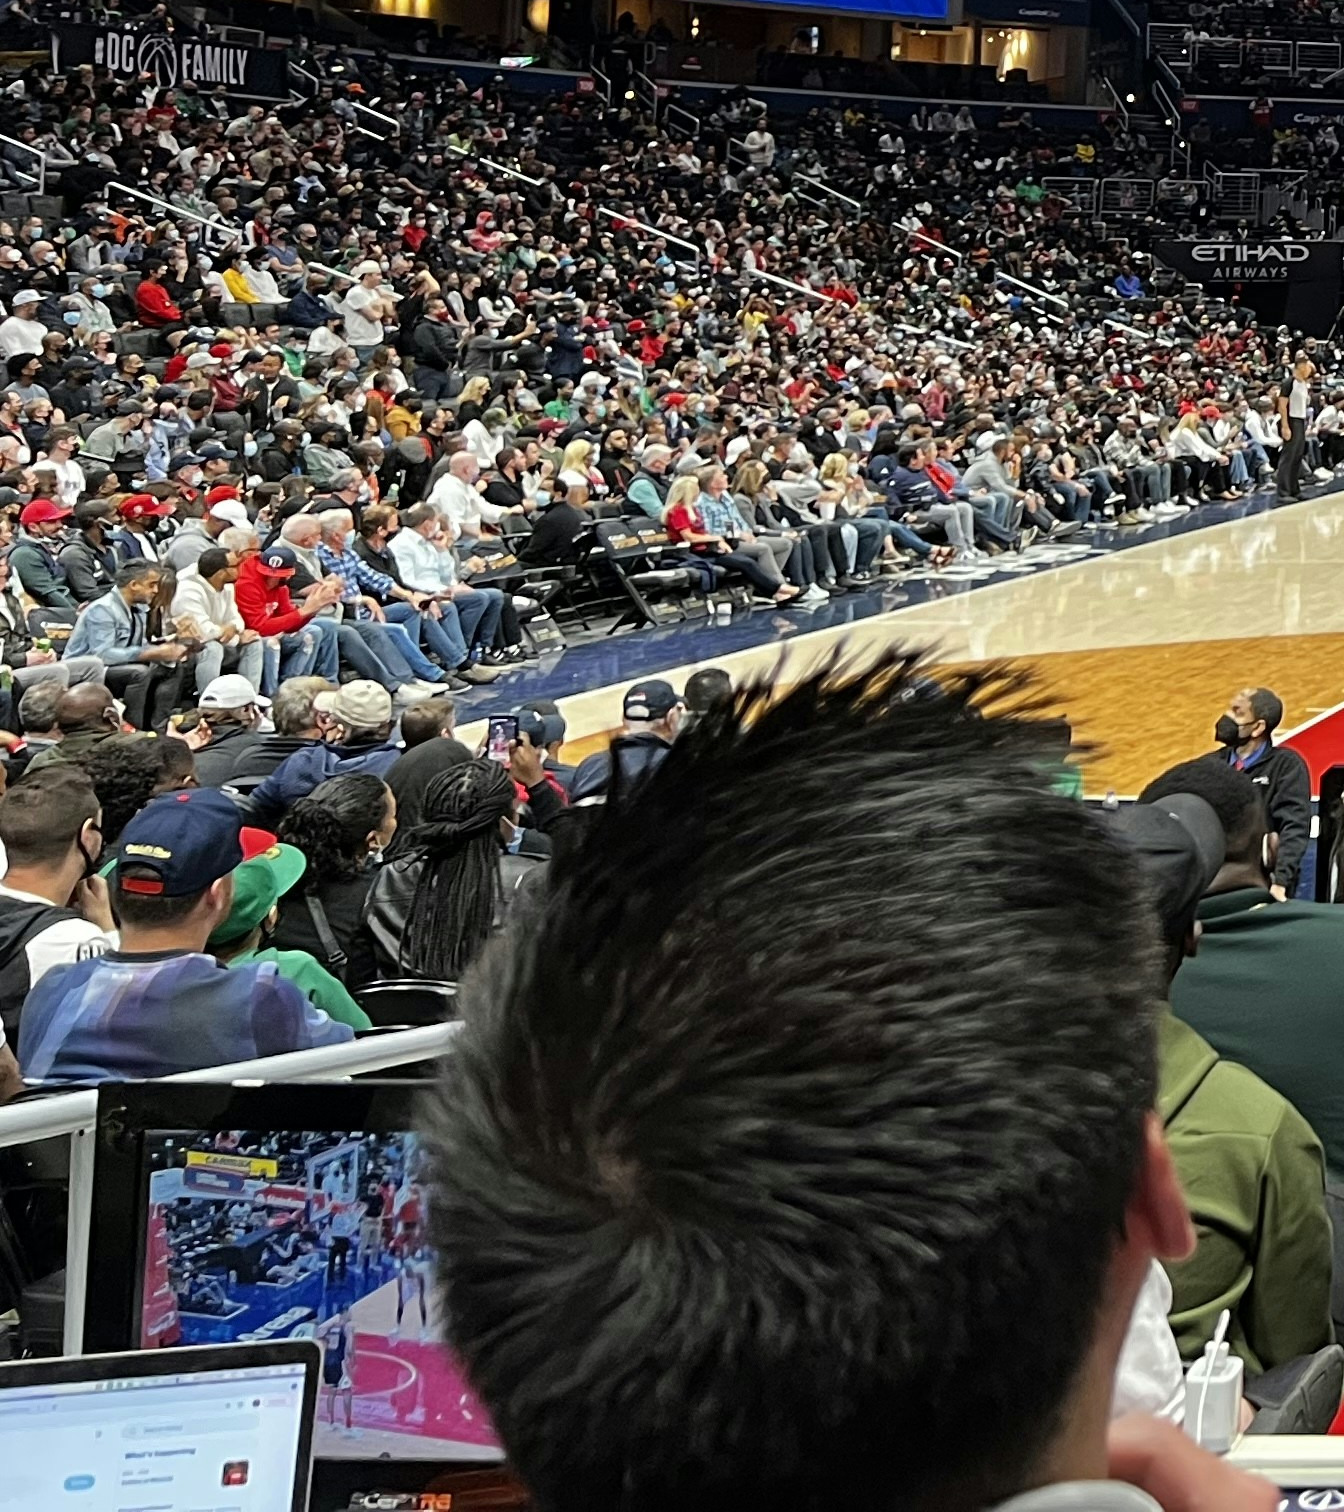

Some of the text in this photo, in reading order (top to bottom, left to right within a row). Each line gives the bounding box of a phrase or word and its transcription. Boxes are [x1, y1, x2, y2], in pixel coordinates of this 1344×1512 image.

[182, 43, 248, 85] FAMILY
[1191, 243, 1311, 263] ETIHAD
[1212, 266, 1289, 279] AIRWAYS
